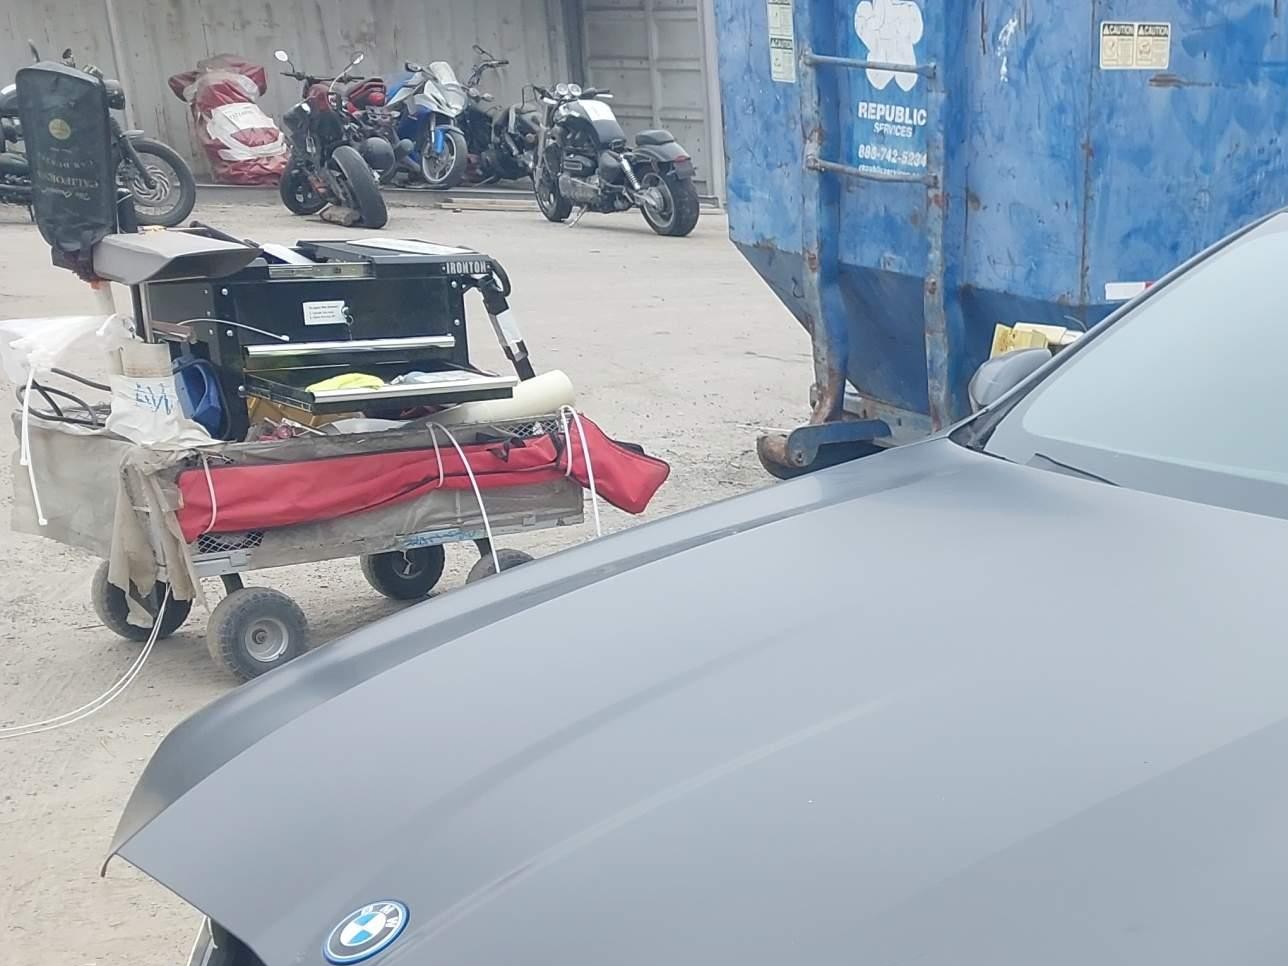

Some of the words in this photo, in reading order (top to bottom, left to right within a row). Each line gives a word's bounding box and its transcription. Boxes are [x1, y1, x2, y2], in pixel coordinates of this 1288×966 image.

[858, 101, 927, 126] REPUBLIC
[873, 122, 913, 138] SERVICES
[446, 261, 487, 274] IRONTON
